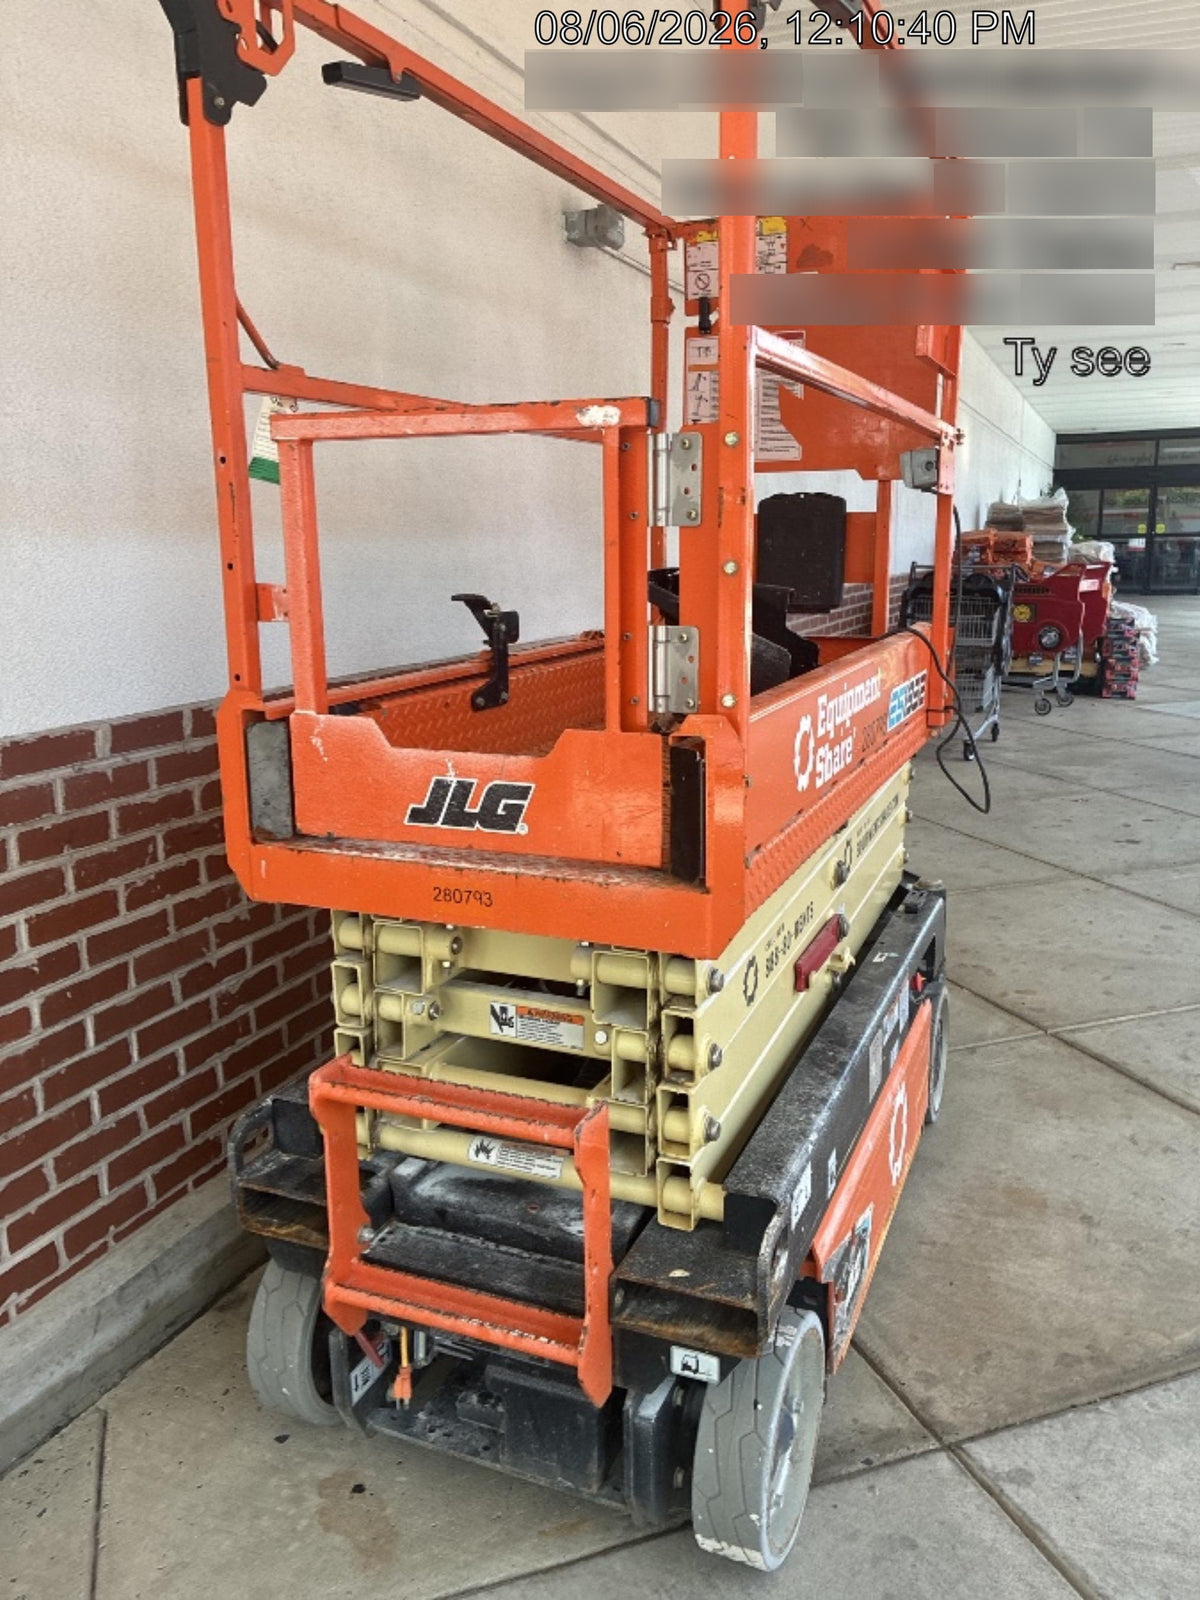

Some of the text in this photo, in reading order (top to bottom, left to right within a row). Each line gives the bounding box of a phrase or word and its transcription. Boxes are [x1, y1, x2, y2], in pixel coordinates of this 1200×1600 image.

[817, 667, 881, 739] Equipment
[815, 735, 854, 789] Share
[404, 776, 535, 834] JLG
[432, 886, 493, 908] 280793
